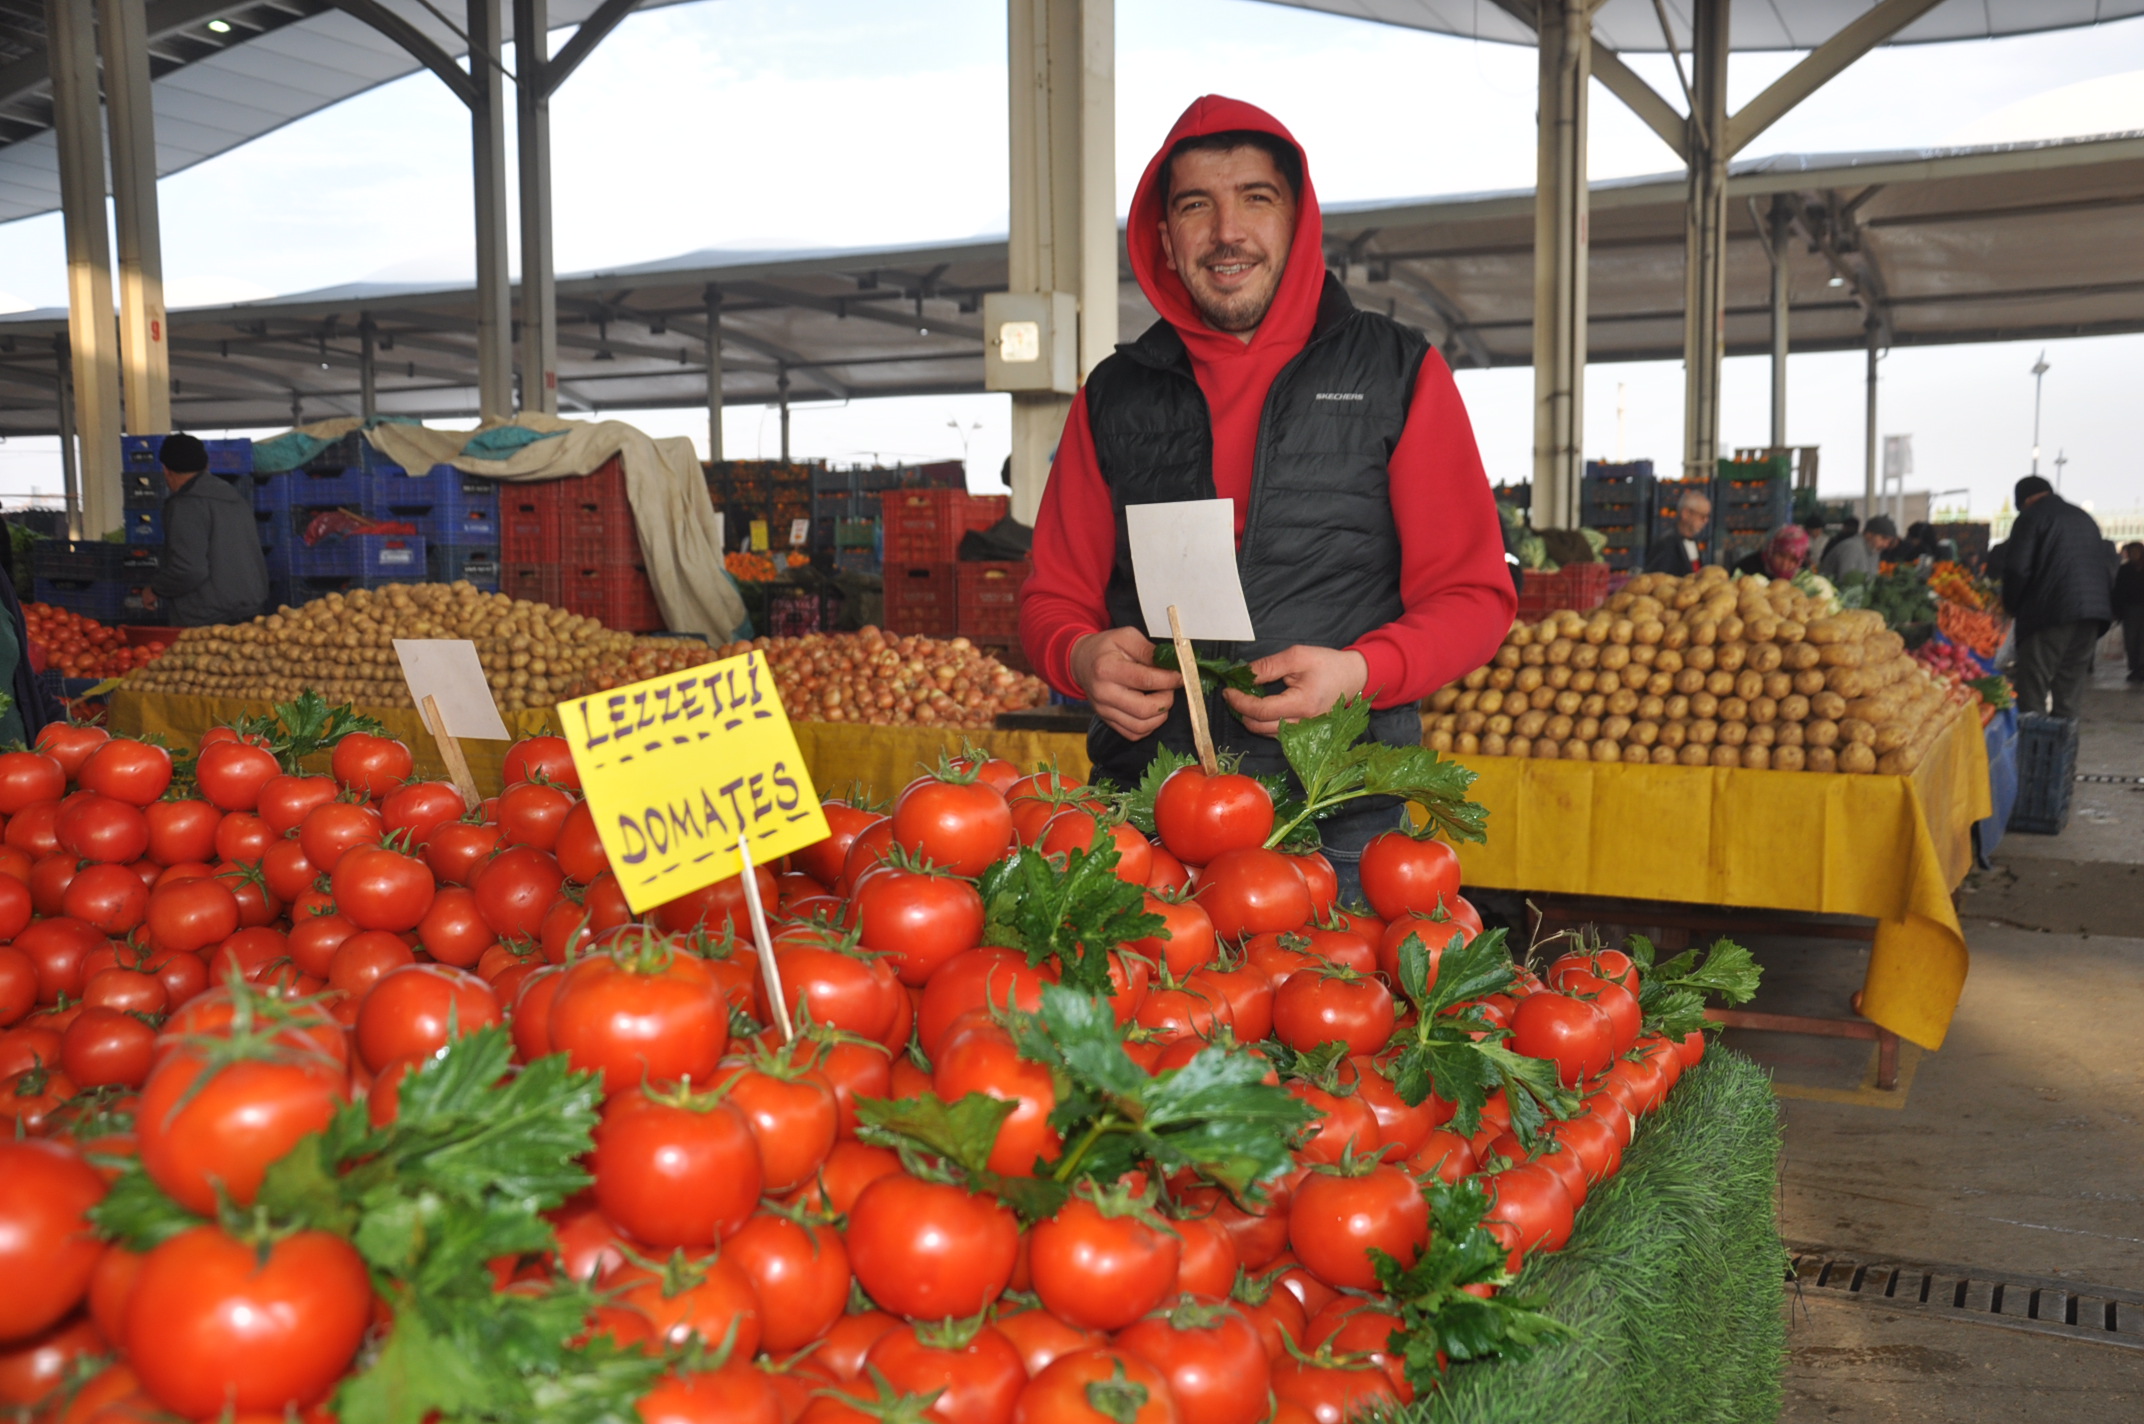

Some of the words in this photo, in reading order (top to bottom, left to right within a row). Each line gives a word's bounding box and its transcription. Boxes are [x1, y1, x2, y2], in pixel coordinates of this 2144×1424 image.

[151, 320, 160, 342] 9
[1315, 392, 1364, 400] SKECHERS
[618, 762, 799, 864] DOMATES
